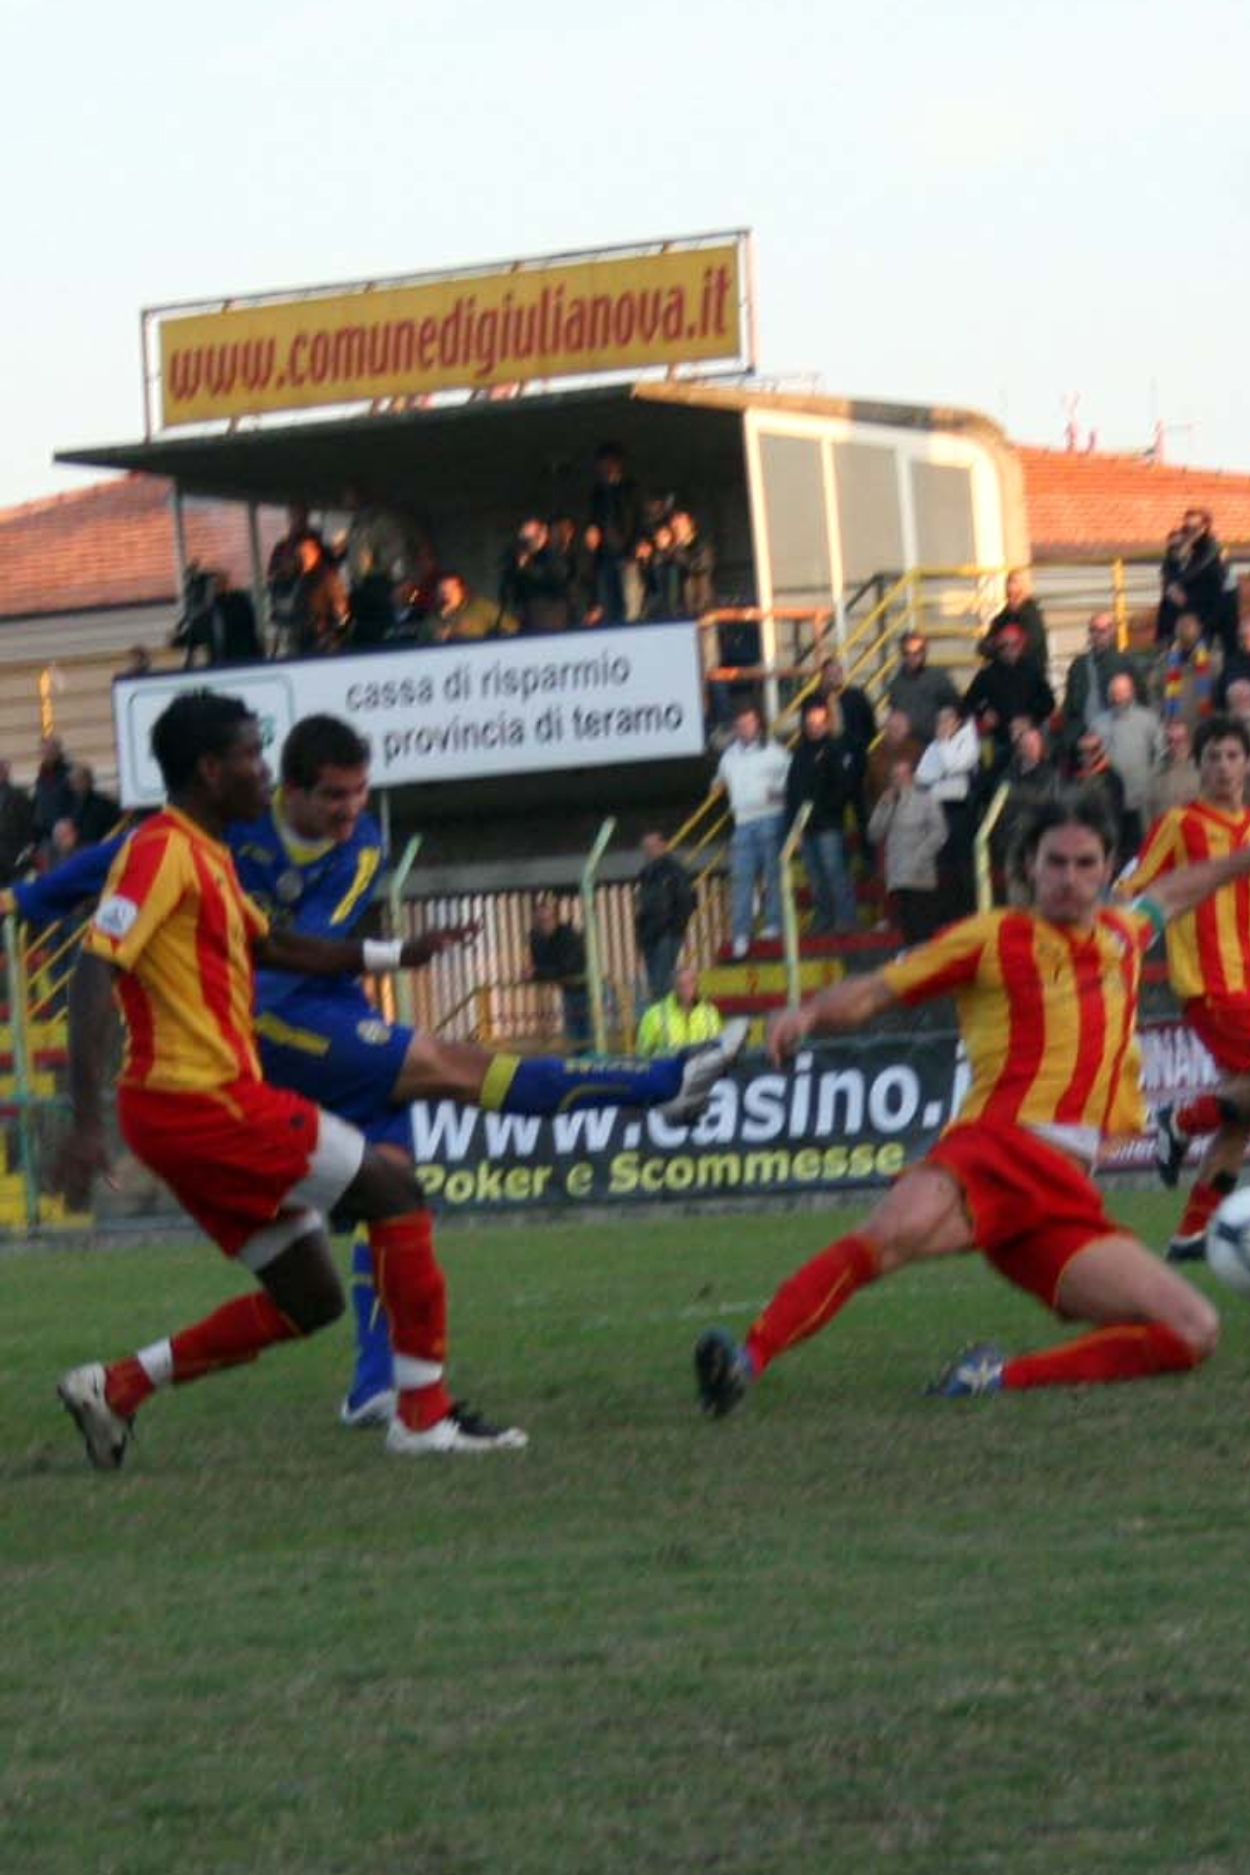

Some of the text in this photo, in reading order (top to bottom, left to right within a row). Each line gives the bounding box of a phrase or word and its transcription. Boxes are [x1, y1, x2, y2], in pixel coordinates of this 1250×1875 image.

[168, 262, 732, 402] www.comunedigiulianova.it
[345, 650, 632, 713] cassa di risparmio
[383, 702, 685, 768] provincia di teramo
[413, 1141, 905, 1205] Poker e Scommesse
